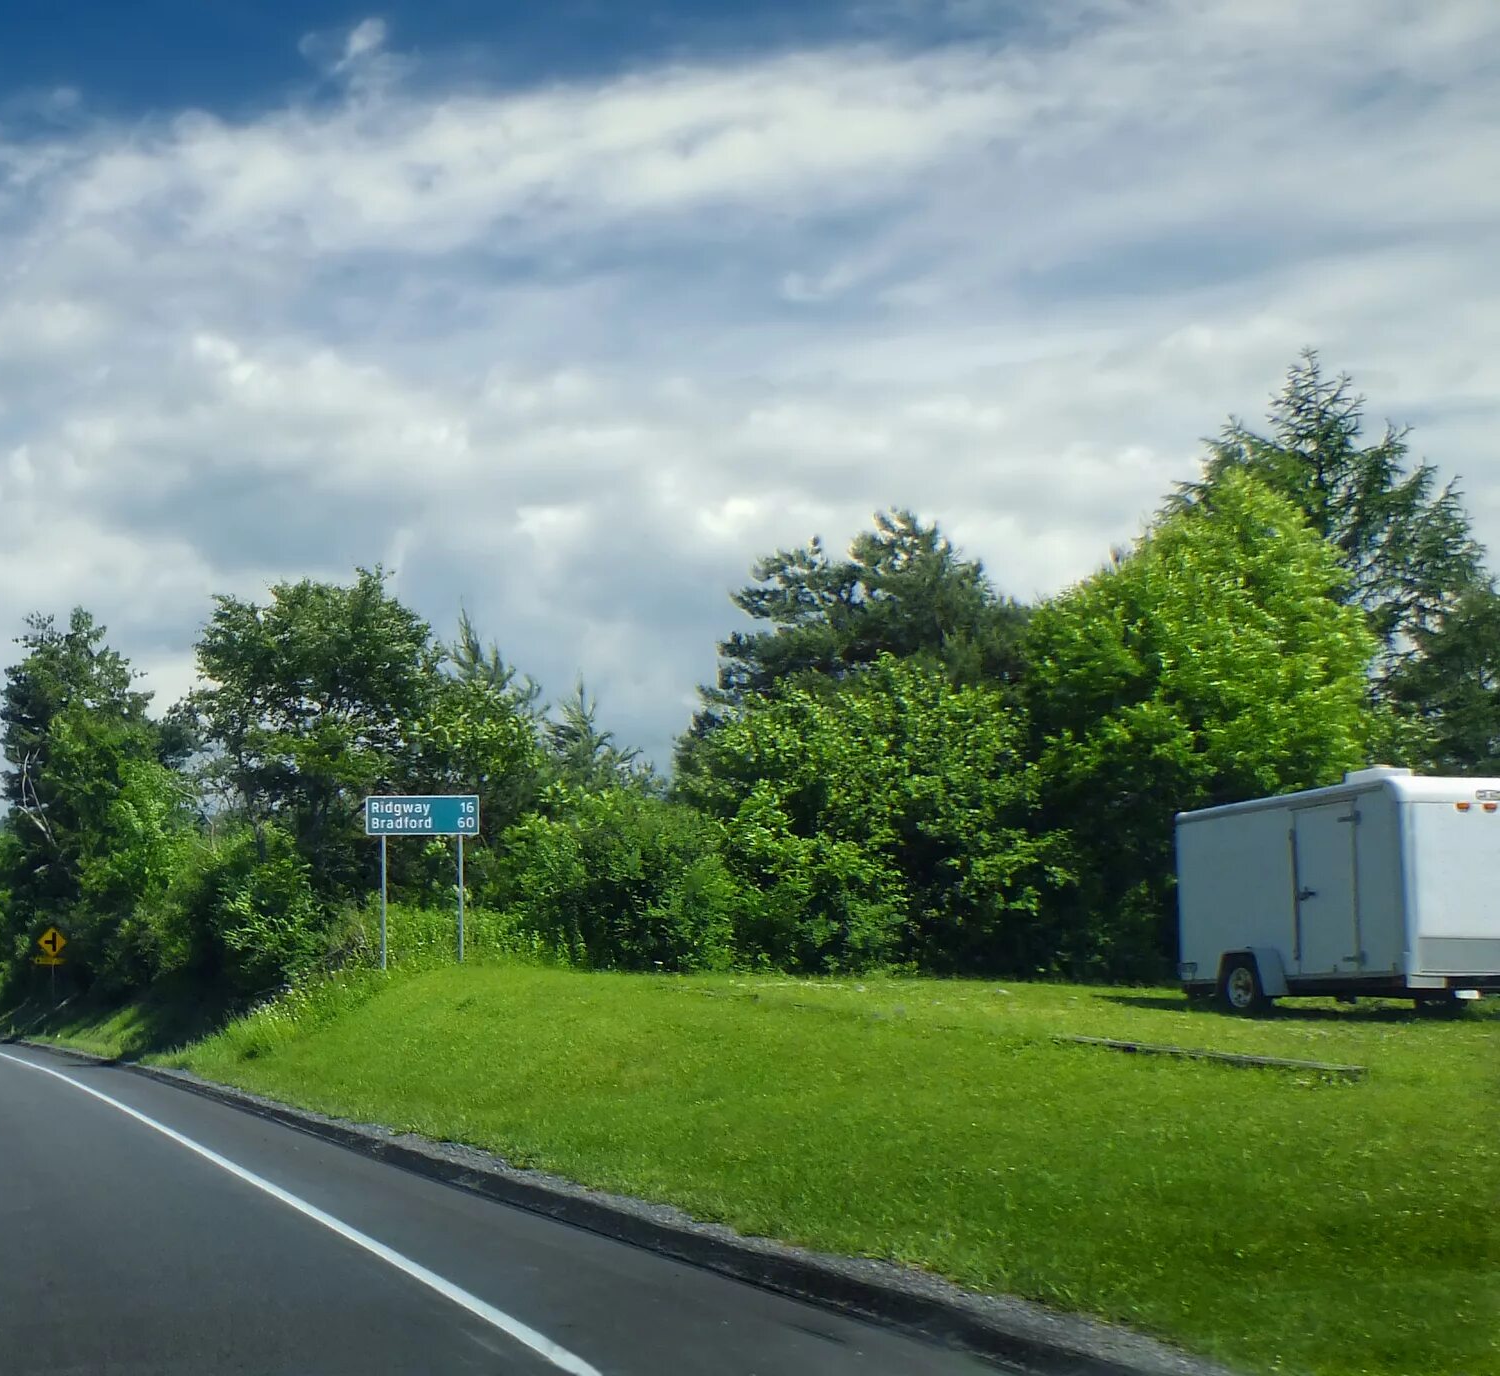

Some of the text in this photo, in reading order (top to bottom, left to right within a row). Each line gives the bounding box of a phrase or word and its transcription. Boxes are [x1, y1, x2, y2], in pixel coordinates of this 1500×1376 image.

[371, 802, 474, 816] Ridgway 16
[371, 817, 474, 828] Bradford 60
